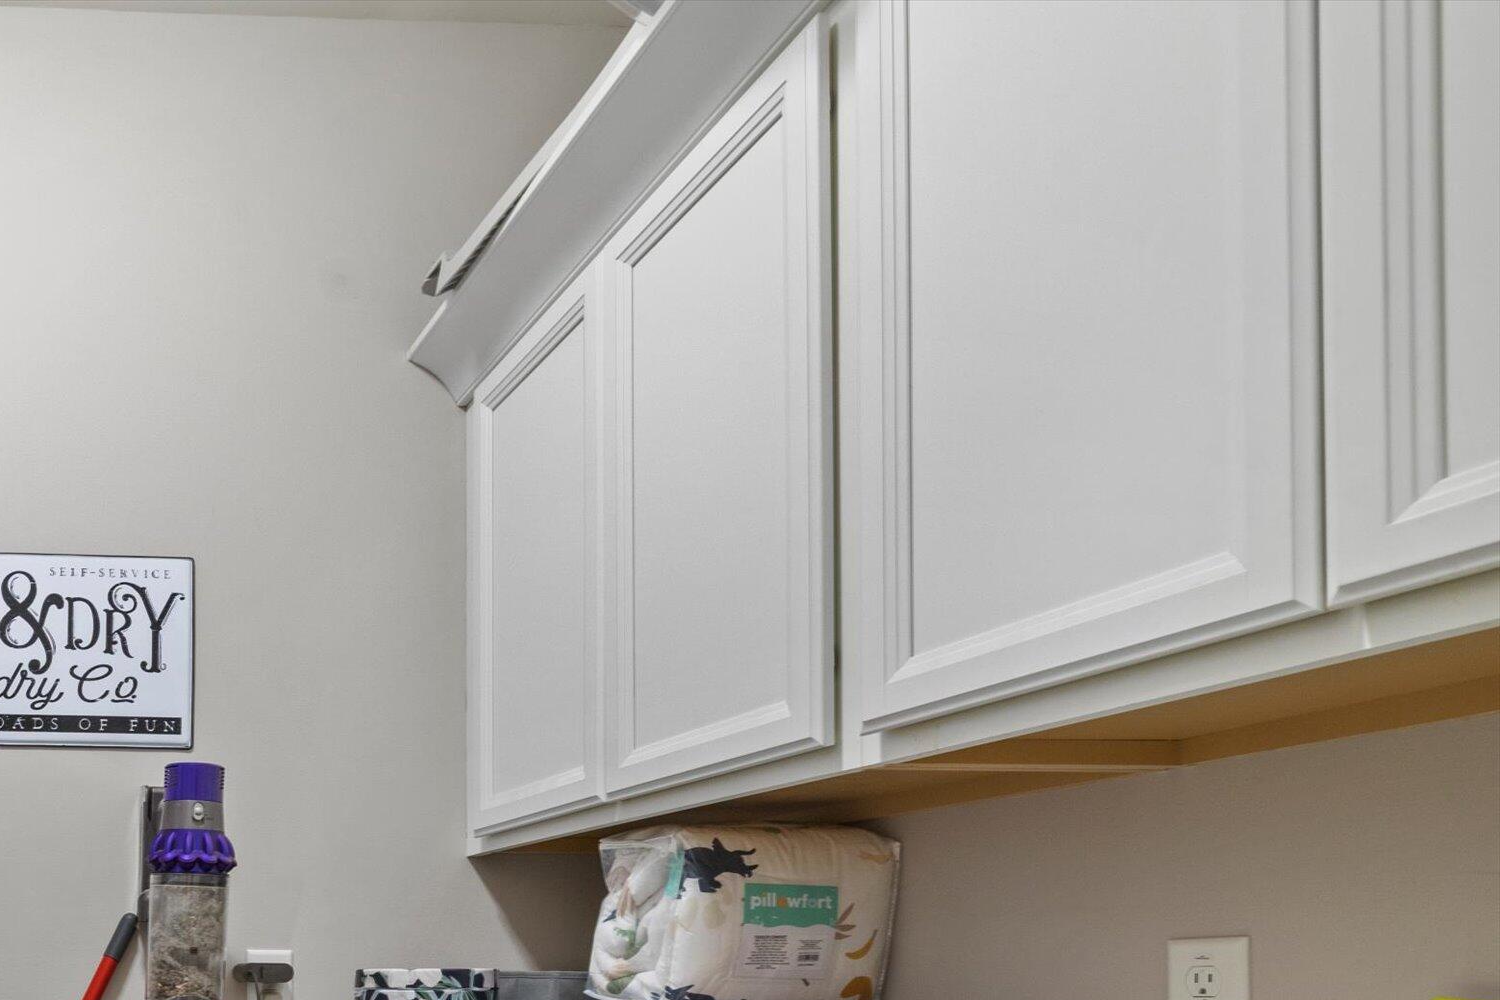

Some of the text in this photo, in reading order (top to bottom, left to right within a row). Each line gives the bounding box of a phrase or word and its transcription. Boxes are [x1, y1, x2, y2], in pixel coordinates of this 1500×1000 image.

[49, 566, 172, 580] SELF-SERVICE
[64, 581, 186, 674] DRY
[78, 718, 109, 731] OF
[128, 718, 177, 733] FUN
[749, 891, 833, 910] pillowfort
